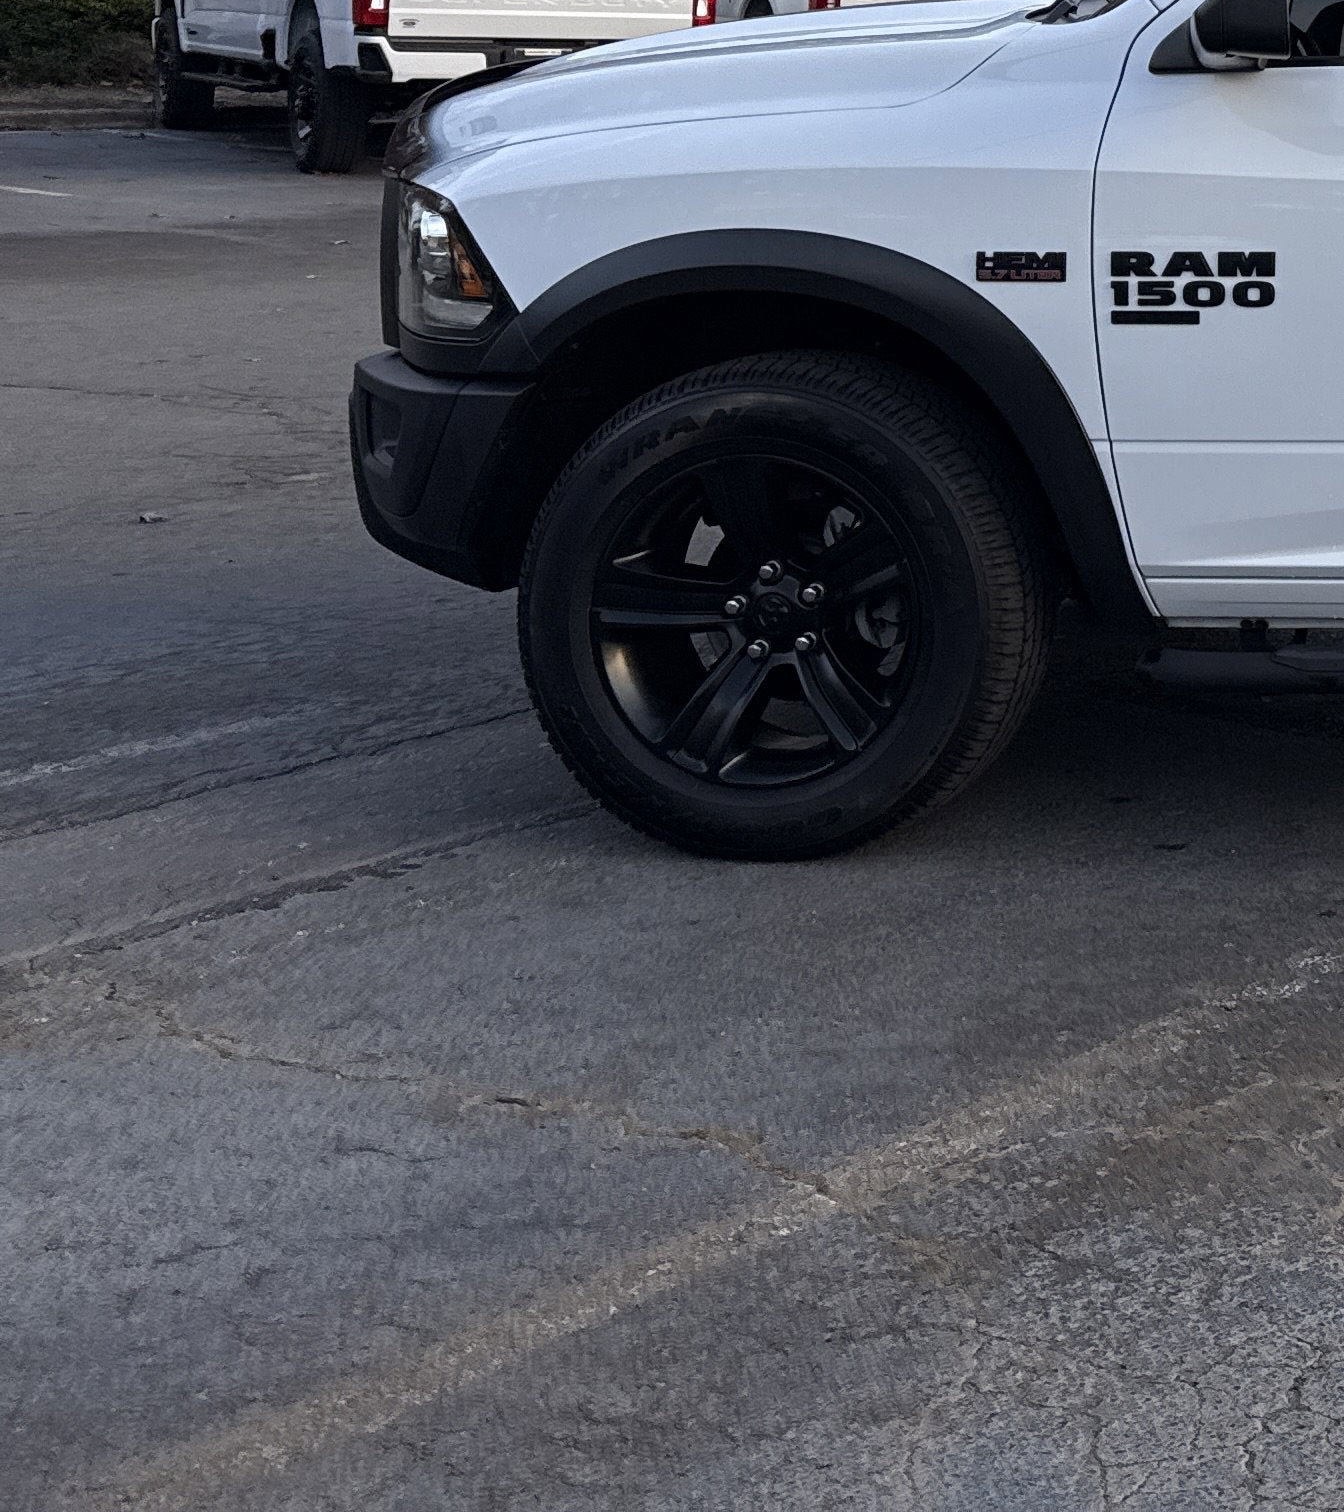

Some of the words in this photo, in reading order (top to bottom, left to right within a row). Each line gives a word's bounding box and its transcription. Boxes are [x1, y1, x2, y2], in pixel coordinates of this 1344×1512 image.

[976, 251, 1067, 269] HEMI
[1110, 251, 1276, 277] RAM
[1110, 280, 1276, 308] 1500
